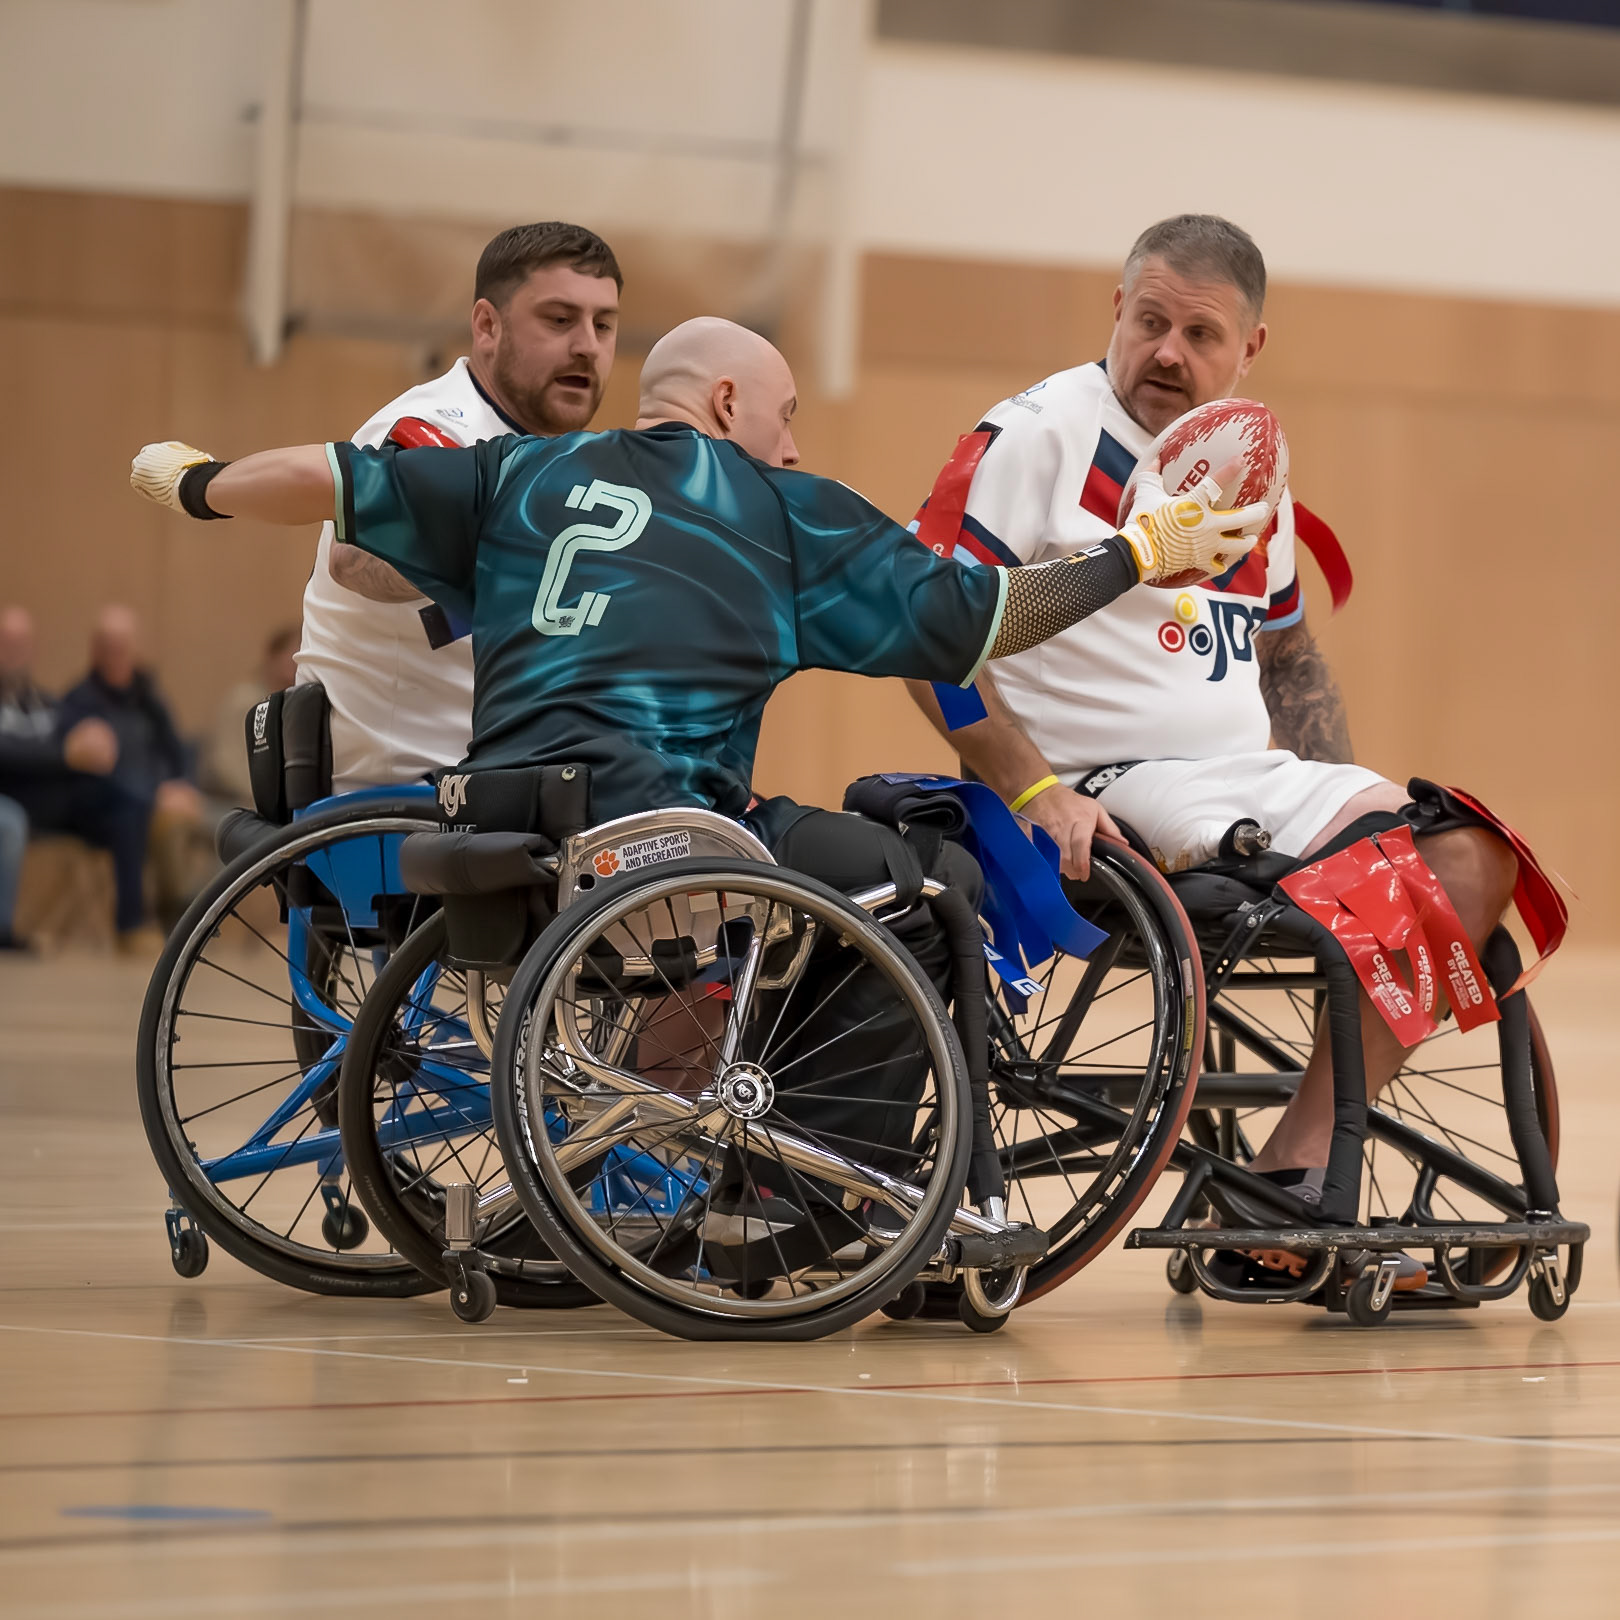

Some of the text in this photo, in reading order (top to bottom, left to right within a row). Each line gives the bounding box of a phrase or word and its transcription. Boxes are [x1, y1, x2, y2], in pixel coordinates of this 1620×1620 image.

[1172, 459, 1210, 496] TED
[532, 479, 652, 636] 2
[622, 831, 689, 858] ADAPTIVE SPORTS
[625, 844, 689, 870] AND RECREATION
[1371, 971, 1382, 983] BY
[1372, 953, 1412, 1015] CREATED
[1418, 945, 1433, 1013] CREATED
[1450, 941, 1483, 1005] CREATED
